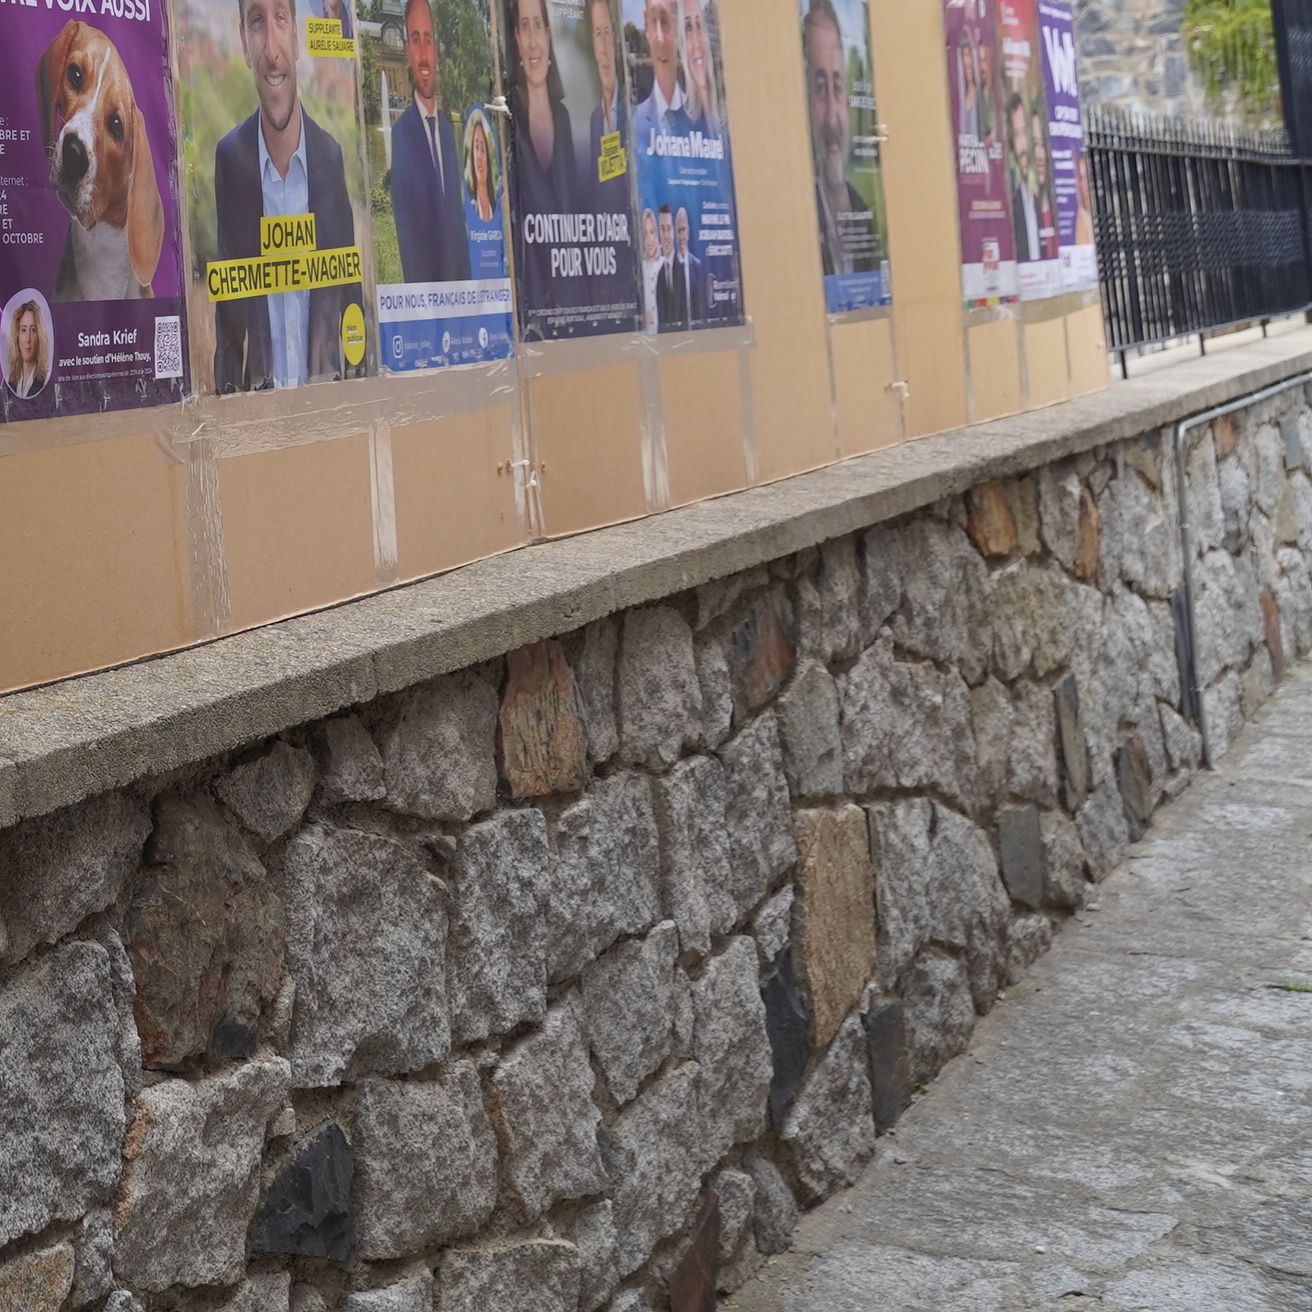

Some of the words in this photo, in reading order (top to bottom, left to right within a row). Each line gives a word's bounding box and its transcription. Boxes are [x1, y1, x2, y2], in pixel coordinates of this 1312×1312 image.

[20, 130, 30, 141] ET
[2, 233, 44, 244] OCTOBRE
[263, 220, 314, 249] JOHAN
[525, 213, 595, 243] CONTINUER
[597, 212, 631, 246] D'AGIR,
[551, 248, 583, 277] POUR
[584, 247, 616, 275] VOUS
[208, 252, 361, 295] CHERMETTE-WAGNER
[381, 296, 403, 310] POUR
[405, 294, 427, 309] NOUS,
[428, 292, 465, 308] FRANÇAIS
[467, 291, 476, 304] DE
[78, 331, 110, 348] Sandra
[113, 329, 137, 344] Krief
[58, 356, 75, 367] avec
